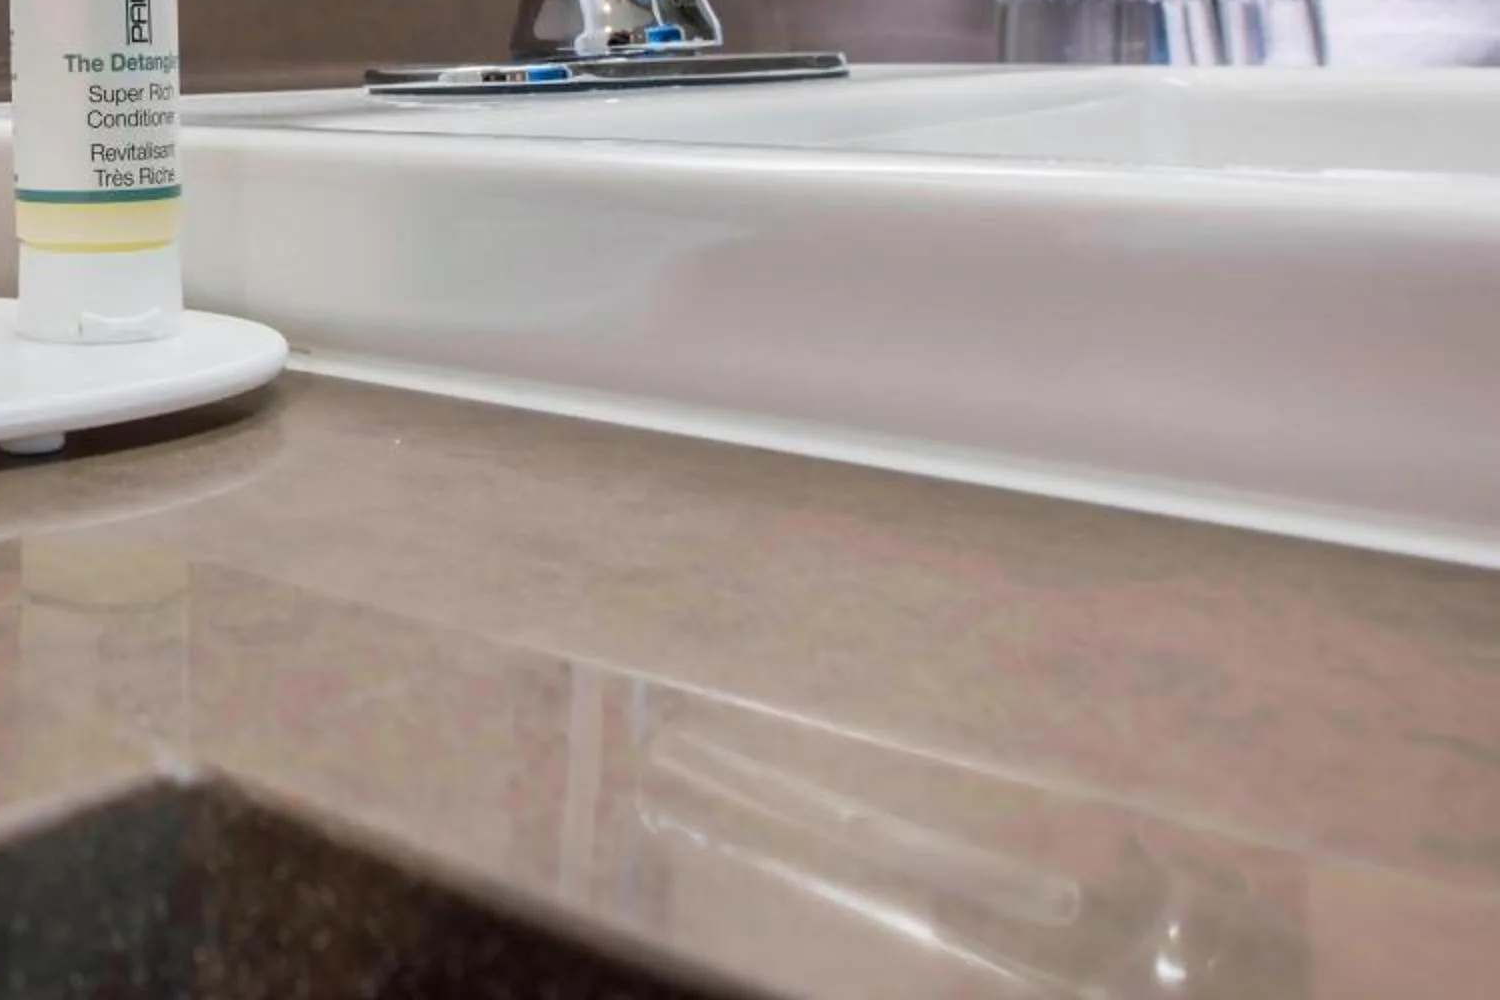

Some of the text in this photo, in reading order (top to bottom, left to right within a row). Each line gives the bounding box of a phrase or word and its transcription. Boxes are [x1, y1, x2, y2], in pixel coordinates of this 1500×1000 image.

[63, 53, 105, 73] The
[88, 85, 144, 106] Super
[92, 166, 175, 188] Très Riche
